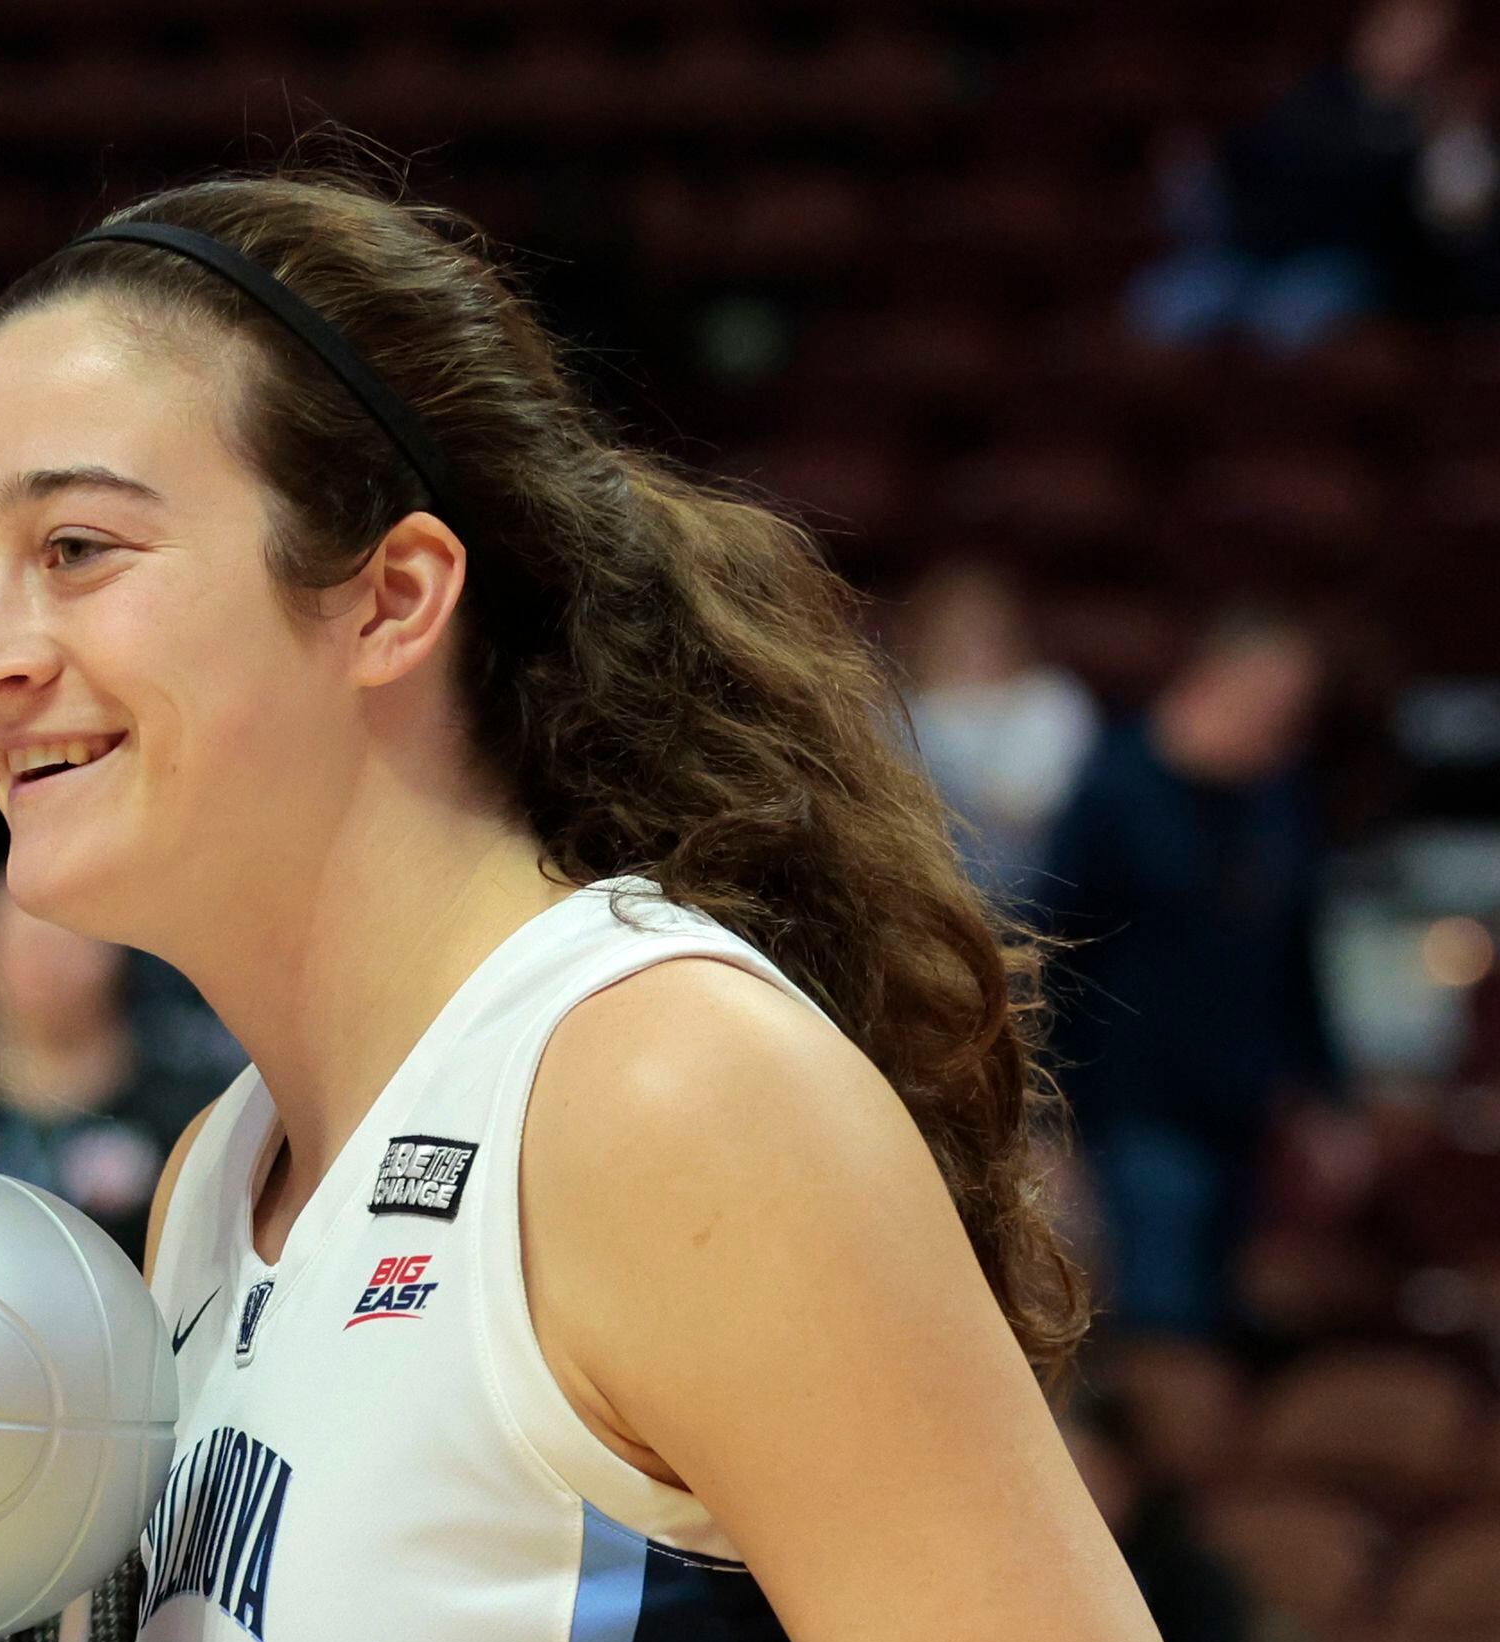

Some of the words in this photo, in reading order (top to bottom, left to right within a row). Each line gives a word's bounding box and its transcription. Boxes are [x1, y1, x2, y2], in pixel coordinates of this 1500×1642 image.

[373, 1178, 457, 1209] CHANGE
[368, 1254, 433, 1287] BIG
[352, 1283, 439, 1314] EAST
